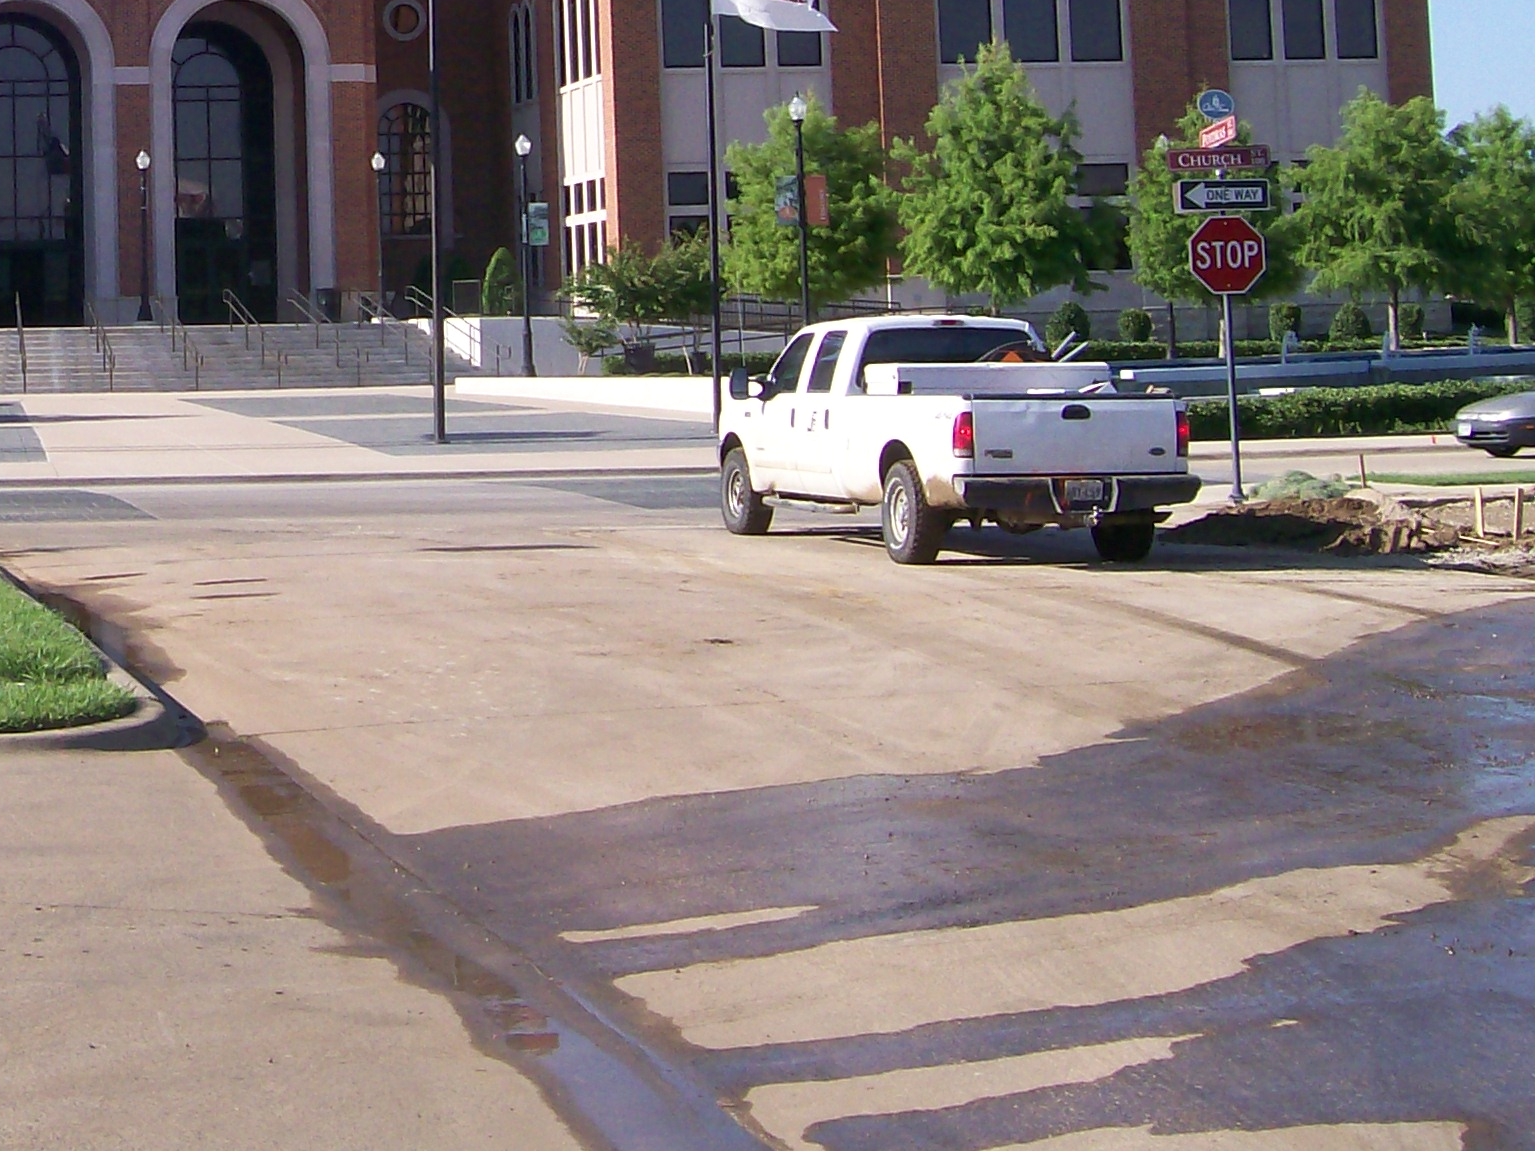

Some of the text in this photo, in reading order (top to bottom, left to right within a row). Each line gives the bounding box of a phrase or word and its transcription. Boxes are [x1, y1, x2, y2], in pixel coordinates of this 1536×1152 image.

[1178, 152, 1242, 167] CHURCH
[1206, 189, 1259, 201] ONE WAY
[1195, 240, 1259, 269] STOP
